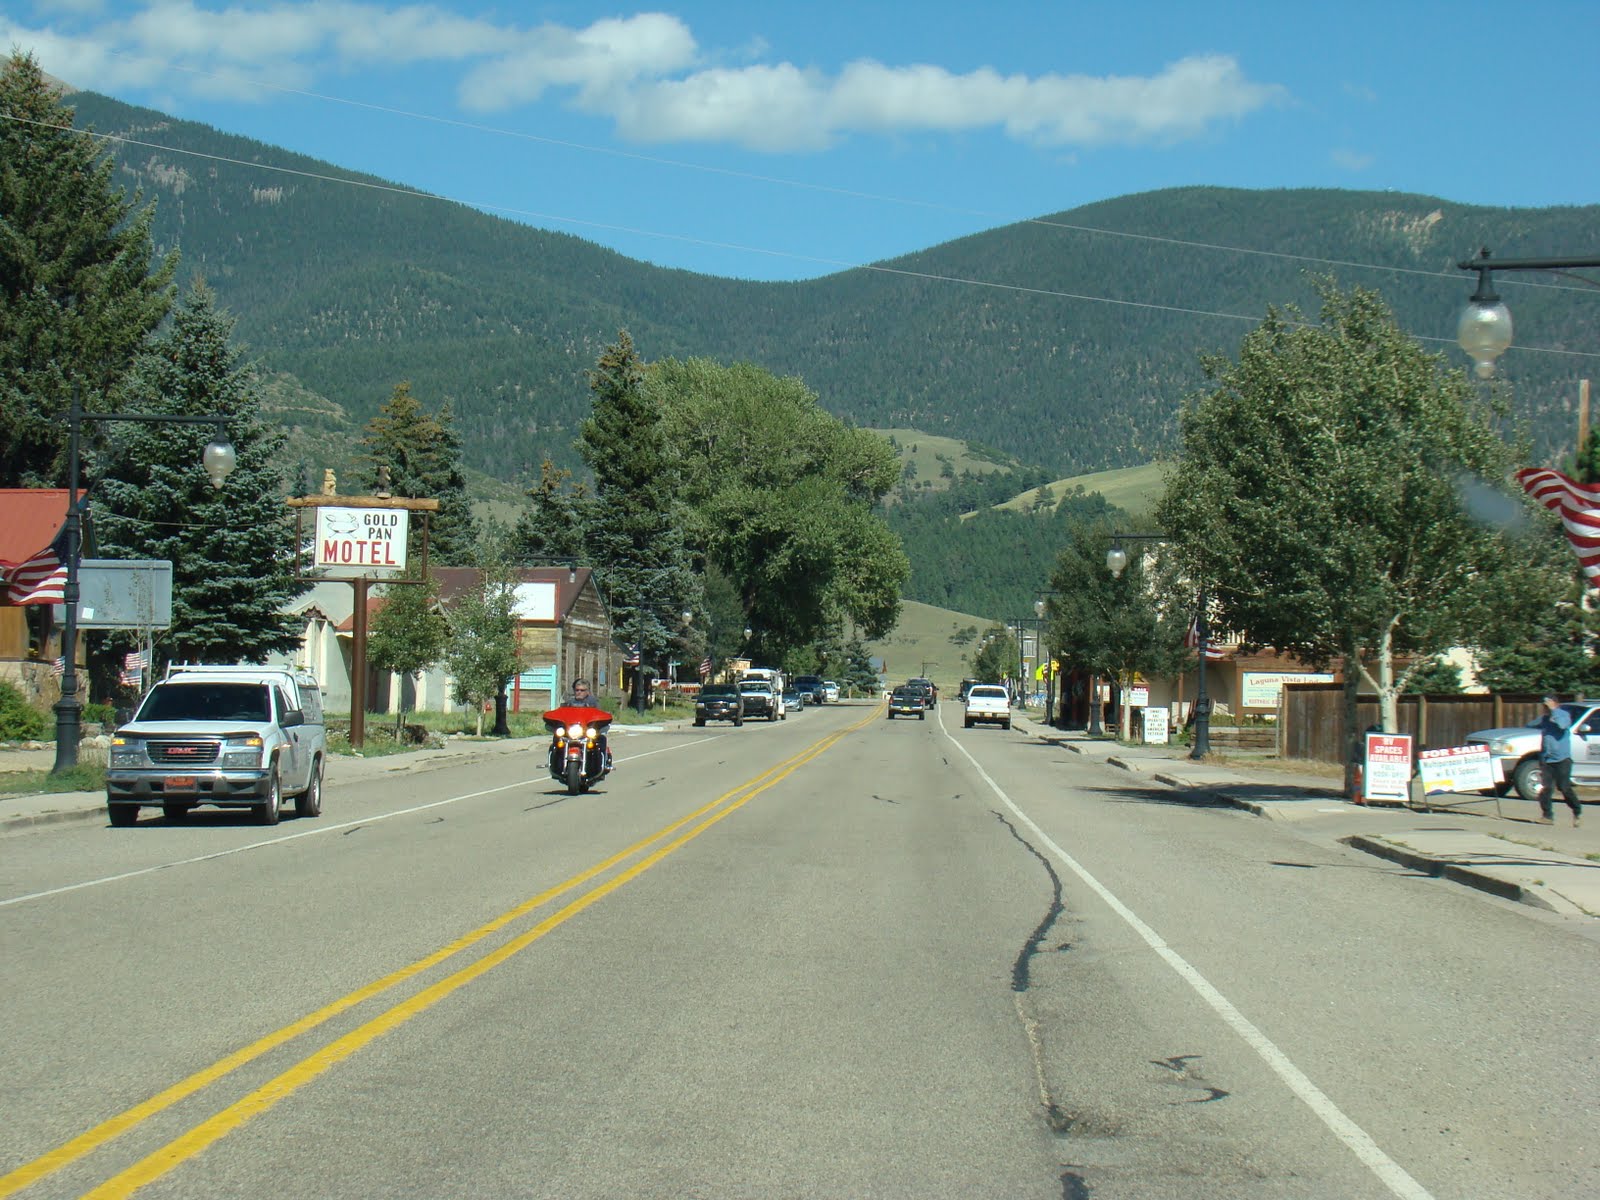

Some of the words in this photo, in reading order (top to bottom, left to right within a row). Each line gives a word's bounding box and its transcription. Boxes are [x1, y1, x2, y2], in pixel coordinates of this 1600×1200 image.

[364, 514, 398, 527] GOLD
[368, 527, 392, 540] PAN
[323, 540, 396, 565] MOTEL
[1250, 678, 1279, 686] Laguna
[1281, 675, 1301, 683] Vista
[1375, 745, 1403, 755] SPACES
[1423, 748, 1449, 759] FOR
[1453, 744, 1486, 755] SALE
[1370, 754, 1409, 764] AVAILABLE
